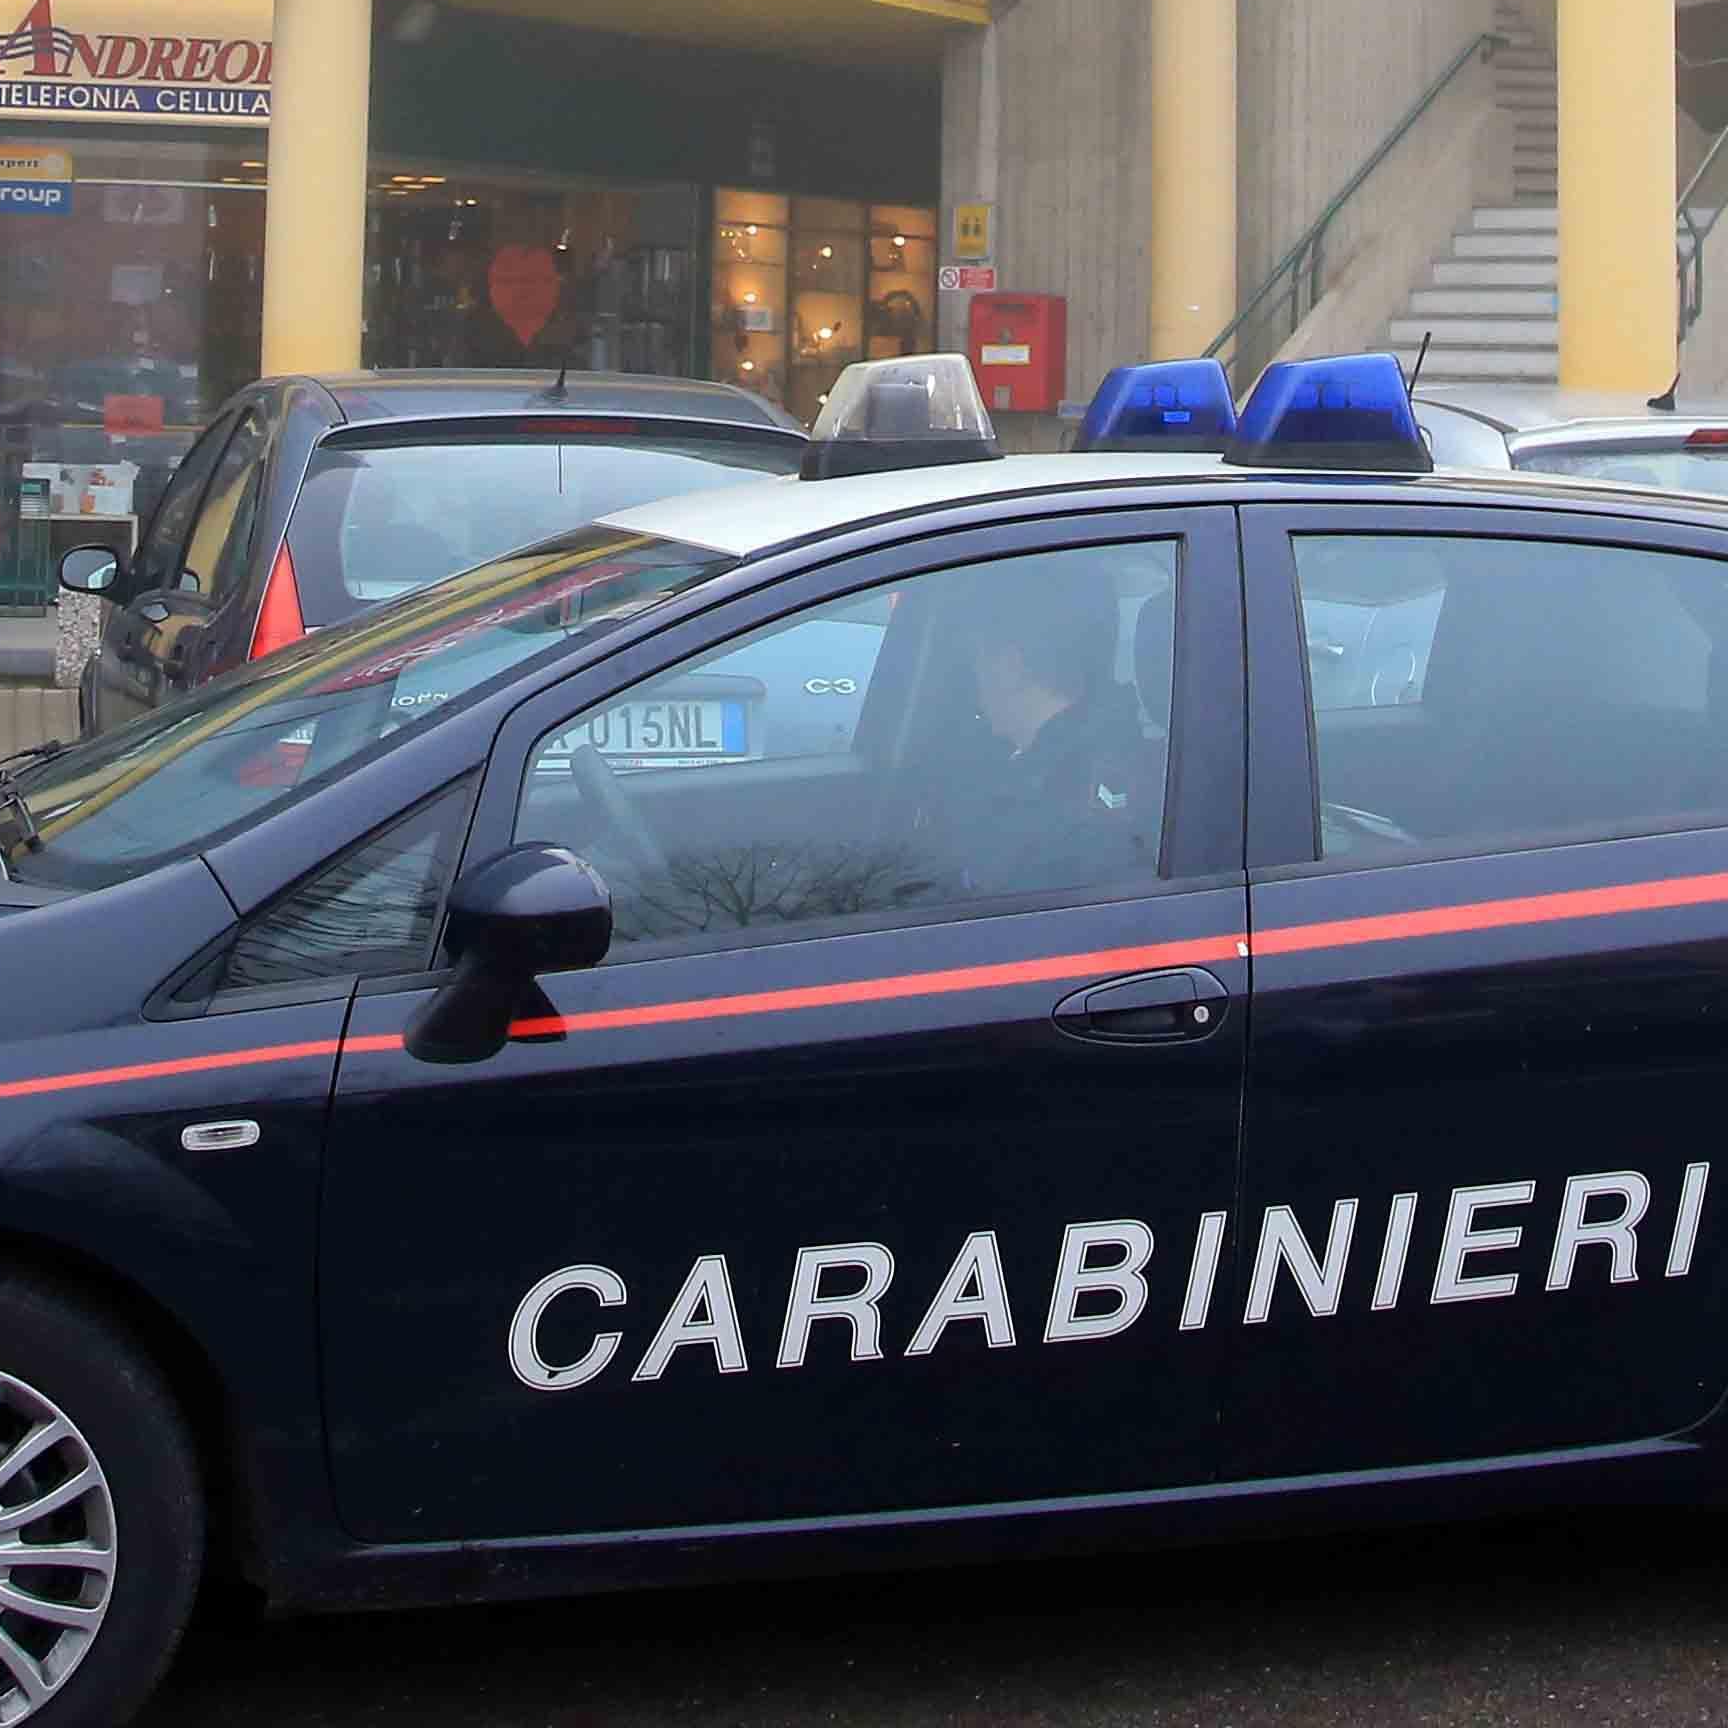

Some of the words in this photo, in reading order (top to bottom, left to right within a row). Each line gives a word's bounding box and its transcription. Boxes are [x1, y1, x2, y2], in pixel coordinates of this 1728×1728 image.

[155, 89, 271, 114] CELLULA
[805, 677, 857, 694] C3
[507, 1160, 1710, 1391] CARABINIERI
